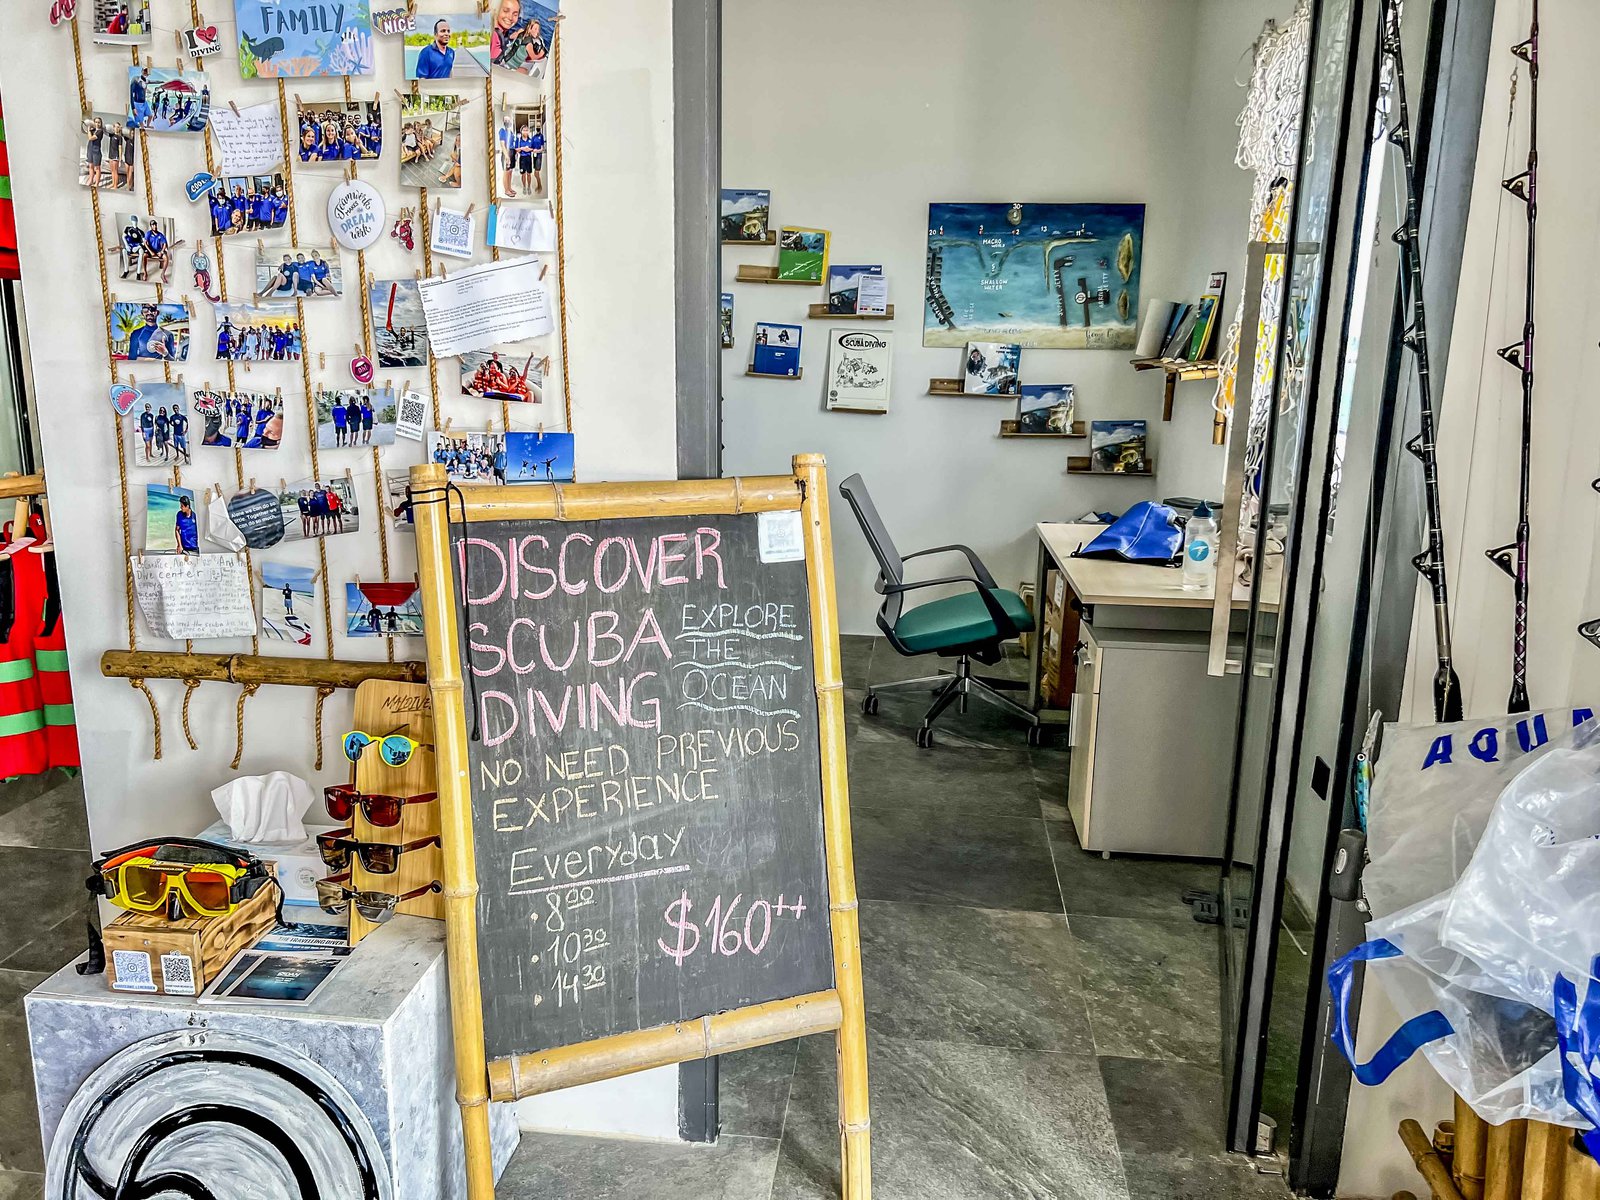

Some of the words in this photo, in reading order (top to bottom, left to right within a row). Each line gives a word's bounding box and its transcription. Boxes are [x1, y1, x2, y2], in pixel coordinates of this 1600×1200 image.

[260, 3, 344, 35] FAMILY
[383, 16, 417, 35] NICE
[185, 30, 198, 49] I
[190, 45, 221, 57] DIVING
[334, 189, 373, 220] Teamwork
[345, 200, 359, 216] MAKES
[341, 212, 375, 234] DREAM
[350, 223, 371, 239] work
[1053, 269, 1061, 288] JETTY
[845, 338, 865, 347] SCUBA
[158, 569, 203, 578] center
[458, 527, 727, 606] DISCOVER
[682, 603, 797, 630] EXPLORE
[467, 608, 673, 677] SCUBA
[687, 638, 740, 662] THE
[682, 669, 787, 700] OCEAN
[380, 694, 432, 711] MALDIVE
[481, 671, 661, 747] DIVING
[480, 758, 522, 791] NO
[545, 744, 630, 781] NEED
[657, 720, 800, 769] PREVIOUS
[492, 769, 719, 832] EXPERIENCE
[510, 827, 686, 886] Everyday
[289, 937, 325, 945] TRAVELLING
